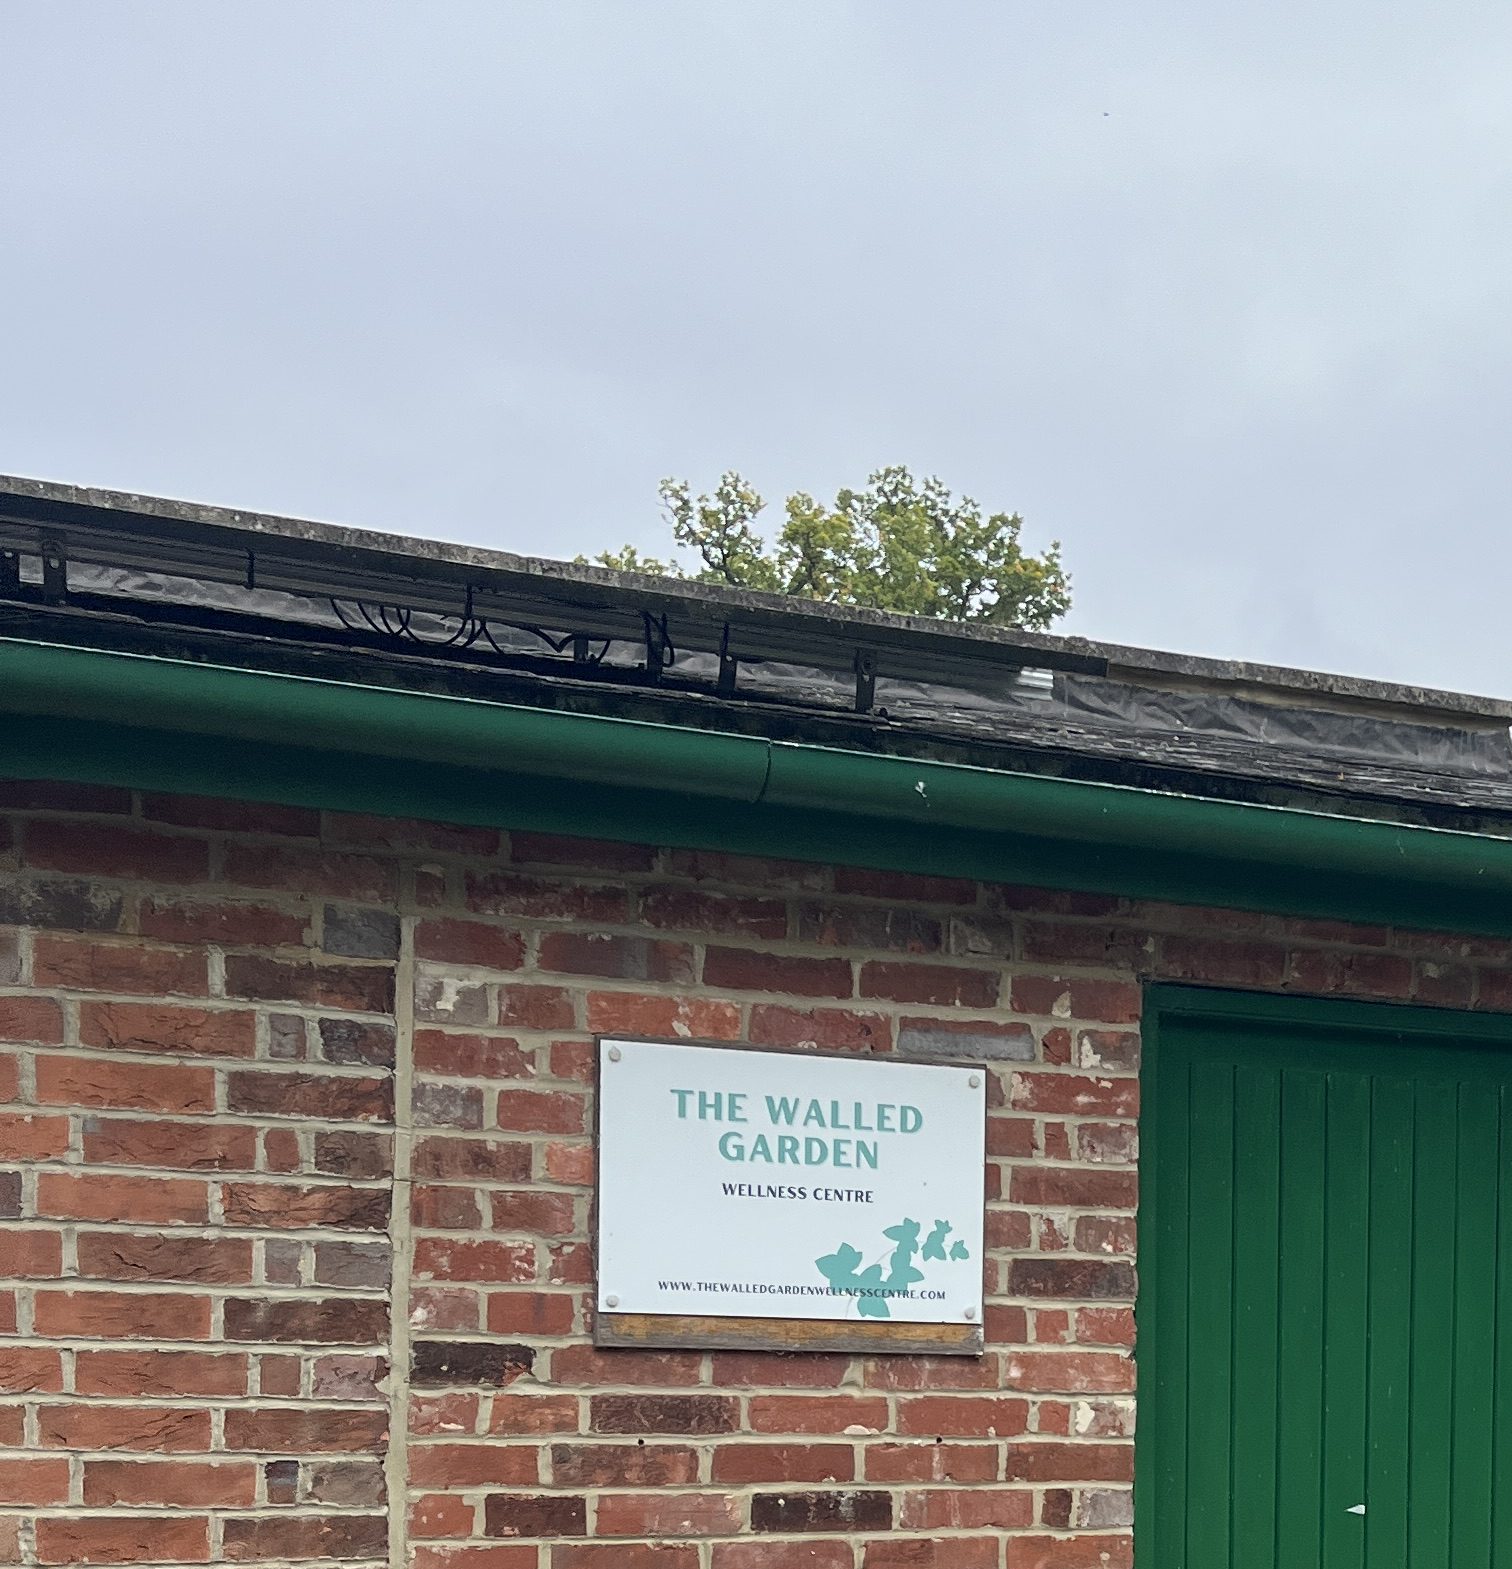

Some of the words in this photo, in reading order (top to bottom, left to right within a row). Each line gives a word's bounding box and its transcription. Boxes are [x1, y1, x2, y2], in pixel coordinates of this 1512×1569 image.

[670, 1089, 748, 1122] THE
[765, 1096, 923, 1133] WALLED
[718, 1132, 879, 1169] GARDEN
[722, 1182, 807, 1200] WELLNESS
[813, 1187, 874, 1203] CENTRE
[658, 1280, 946, 1300] WWW.THEWALLEDGARDENWELLNESSCENTRE.COM
